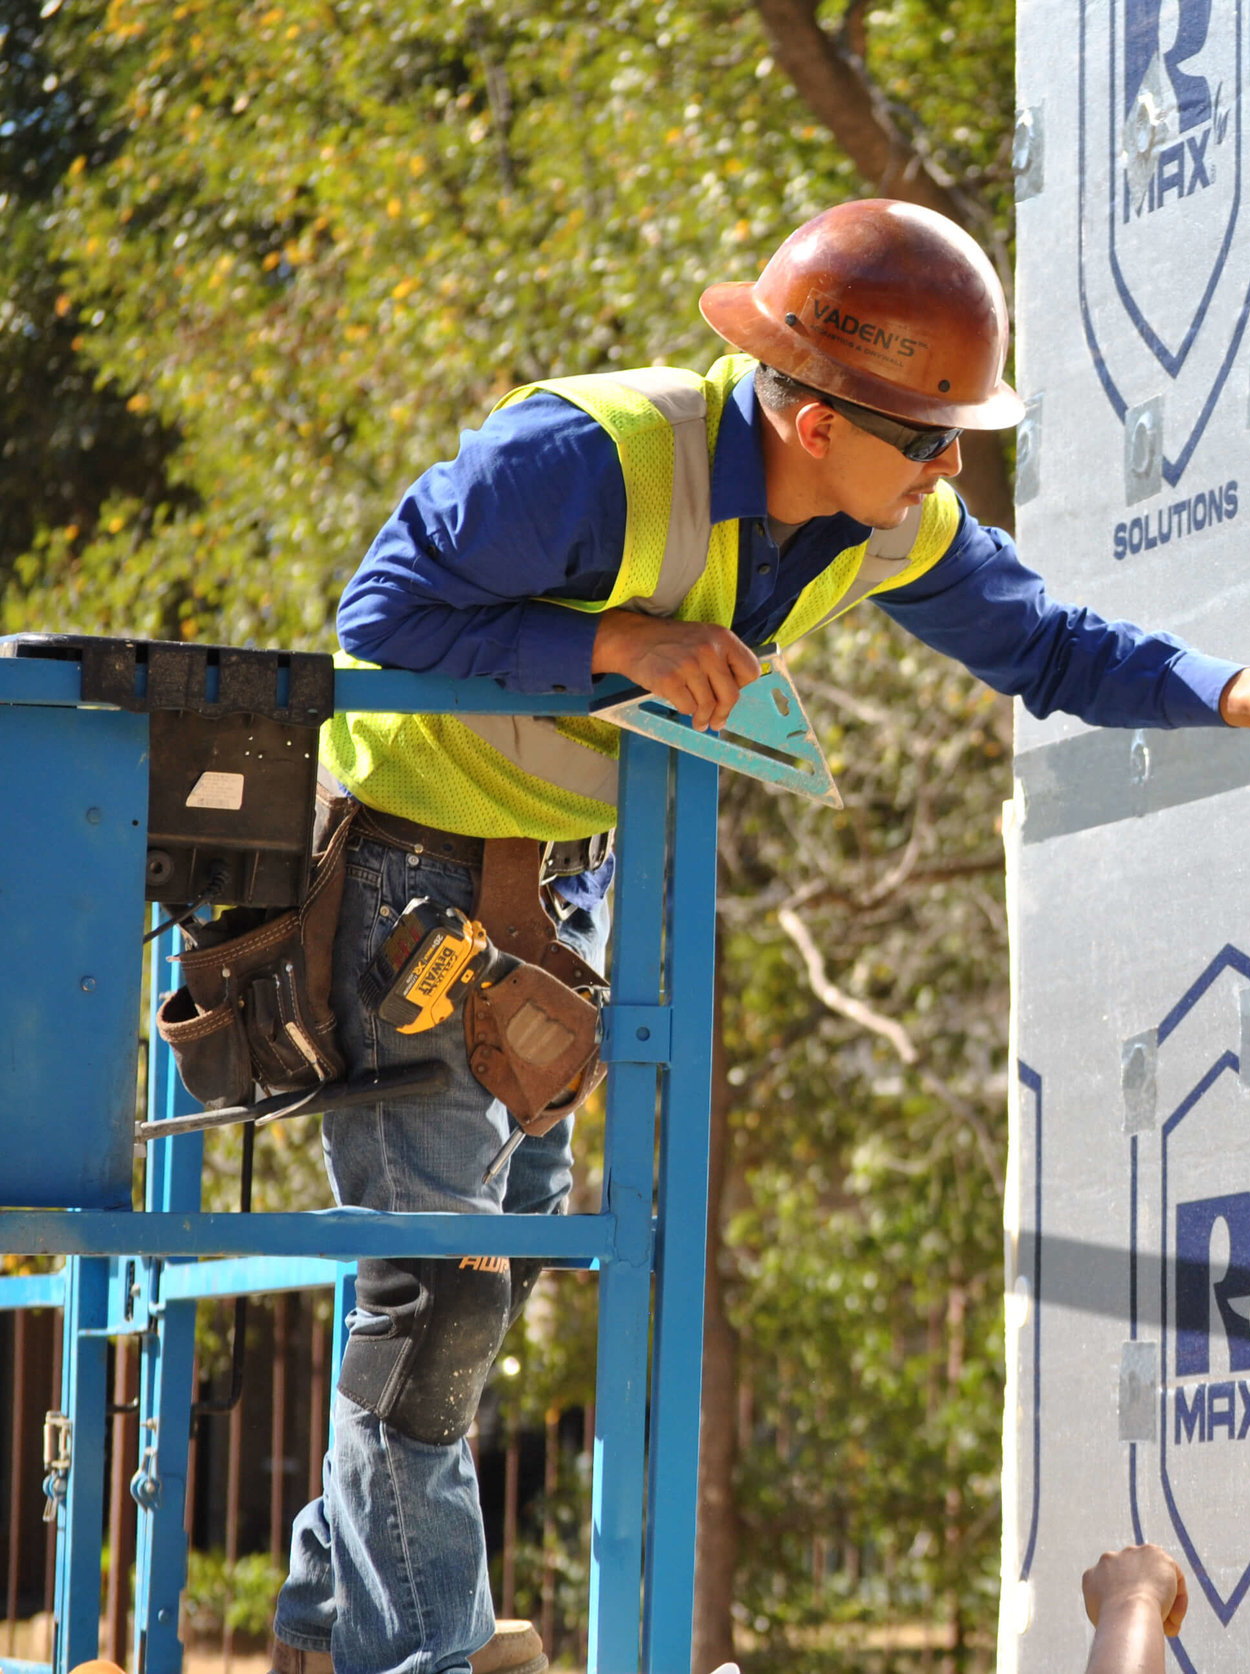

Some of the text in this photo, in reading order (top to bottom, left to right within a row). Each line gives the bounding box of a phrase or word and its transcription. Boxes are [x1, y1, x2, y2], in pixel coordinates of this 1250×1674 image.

[1124, 0, 1212, 134] R
[813, 299, 918, 357] VADEN'S
[1113, 480, 1239, 561] SOLUTIONS
